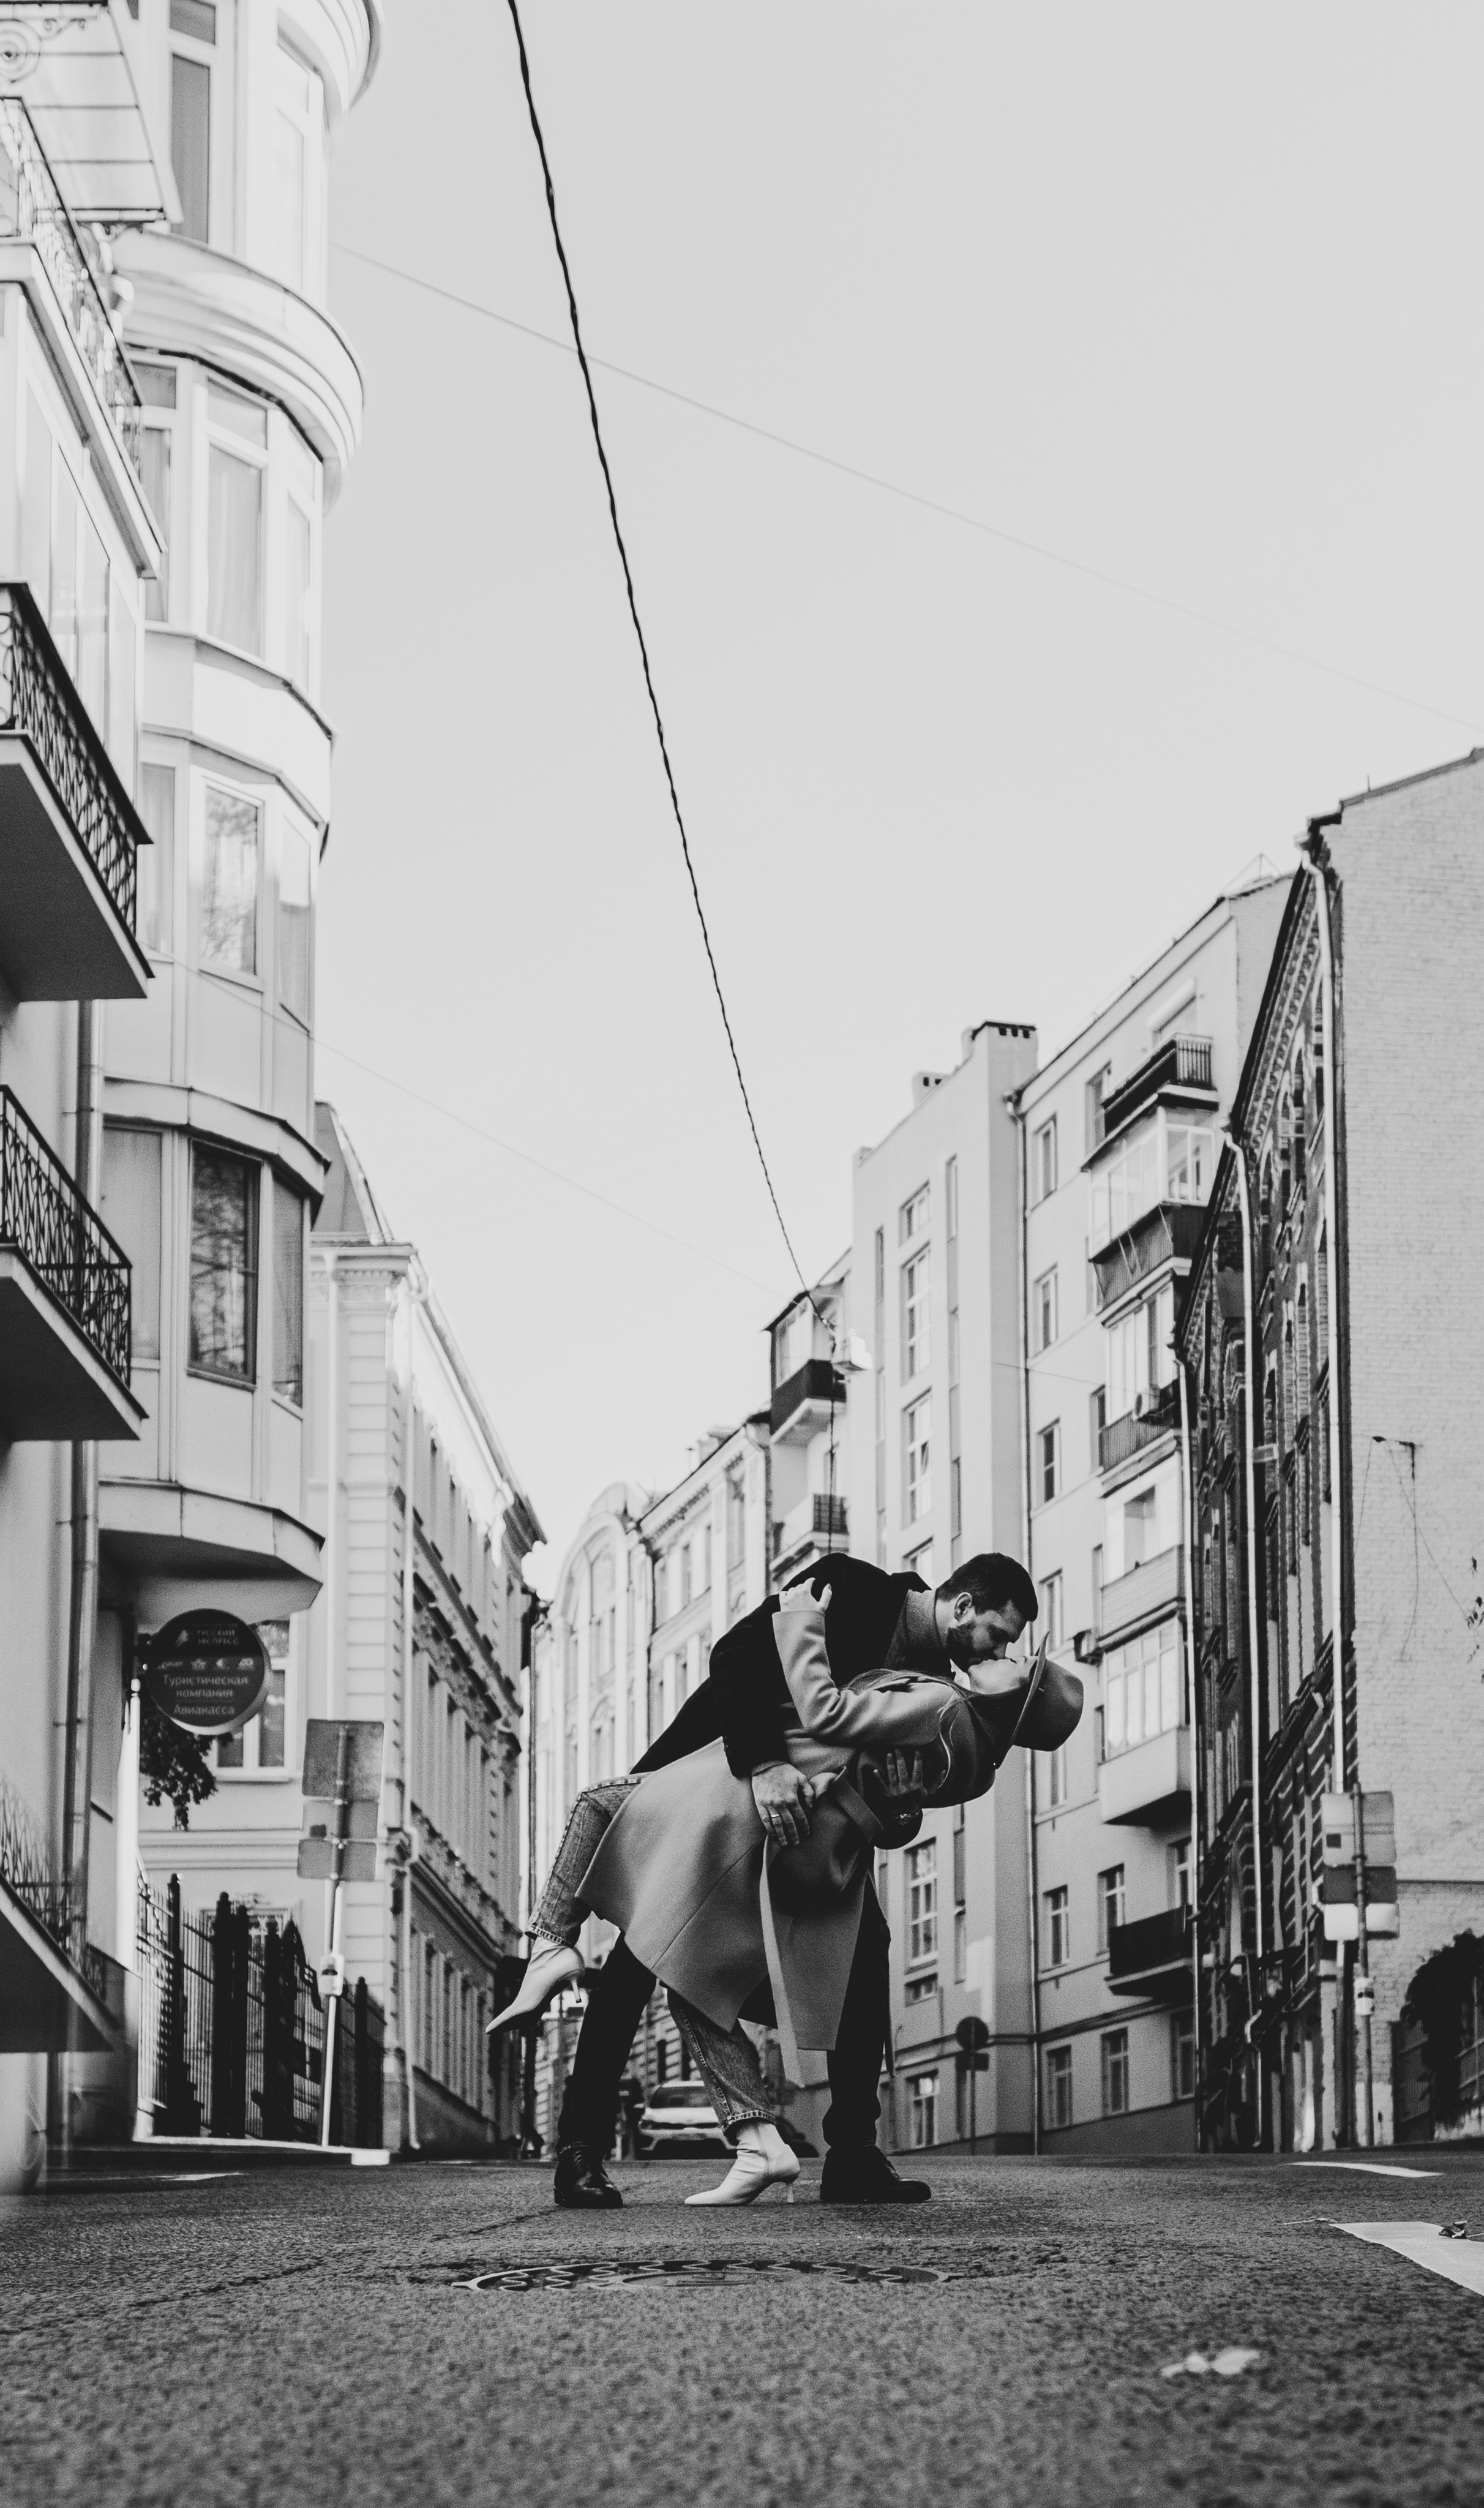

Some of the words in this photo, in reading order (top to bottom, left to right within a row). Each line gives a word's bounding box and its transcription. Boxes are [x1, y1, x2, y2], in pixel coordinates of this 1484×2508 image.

[163, 1674, 249, 1687] Туристическая
[176, 1689, 234, 1698] компания
[173, 1704, 235, 1715] Авиакасса
